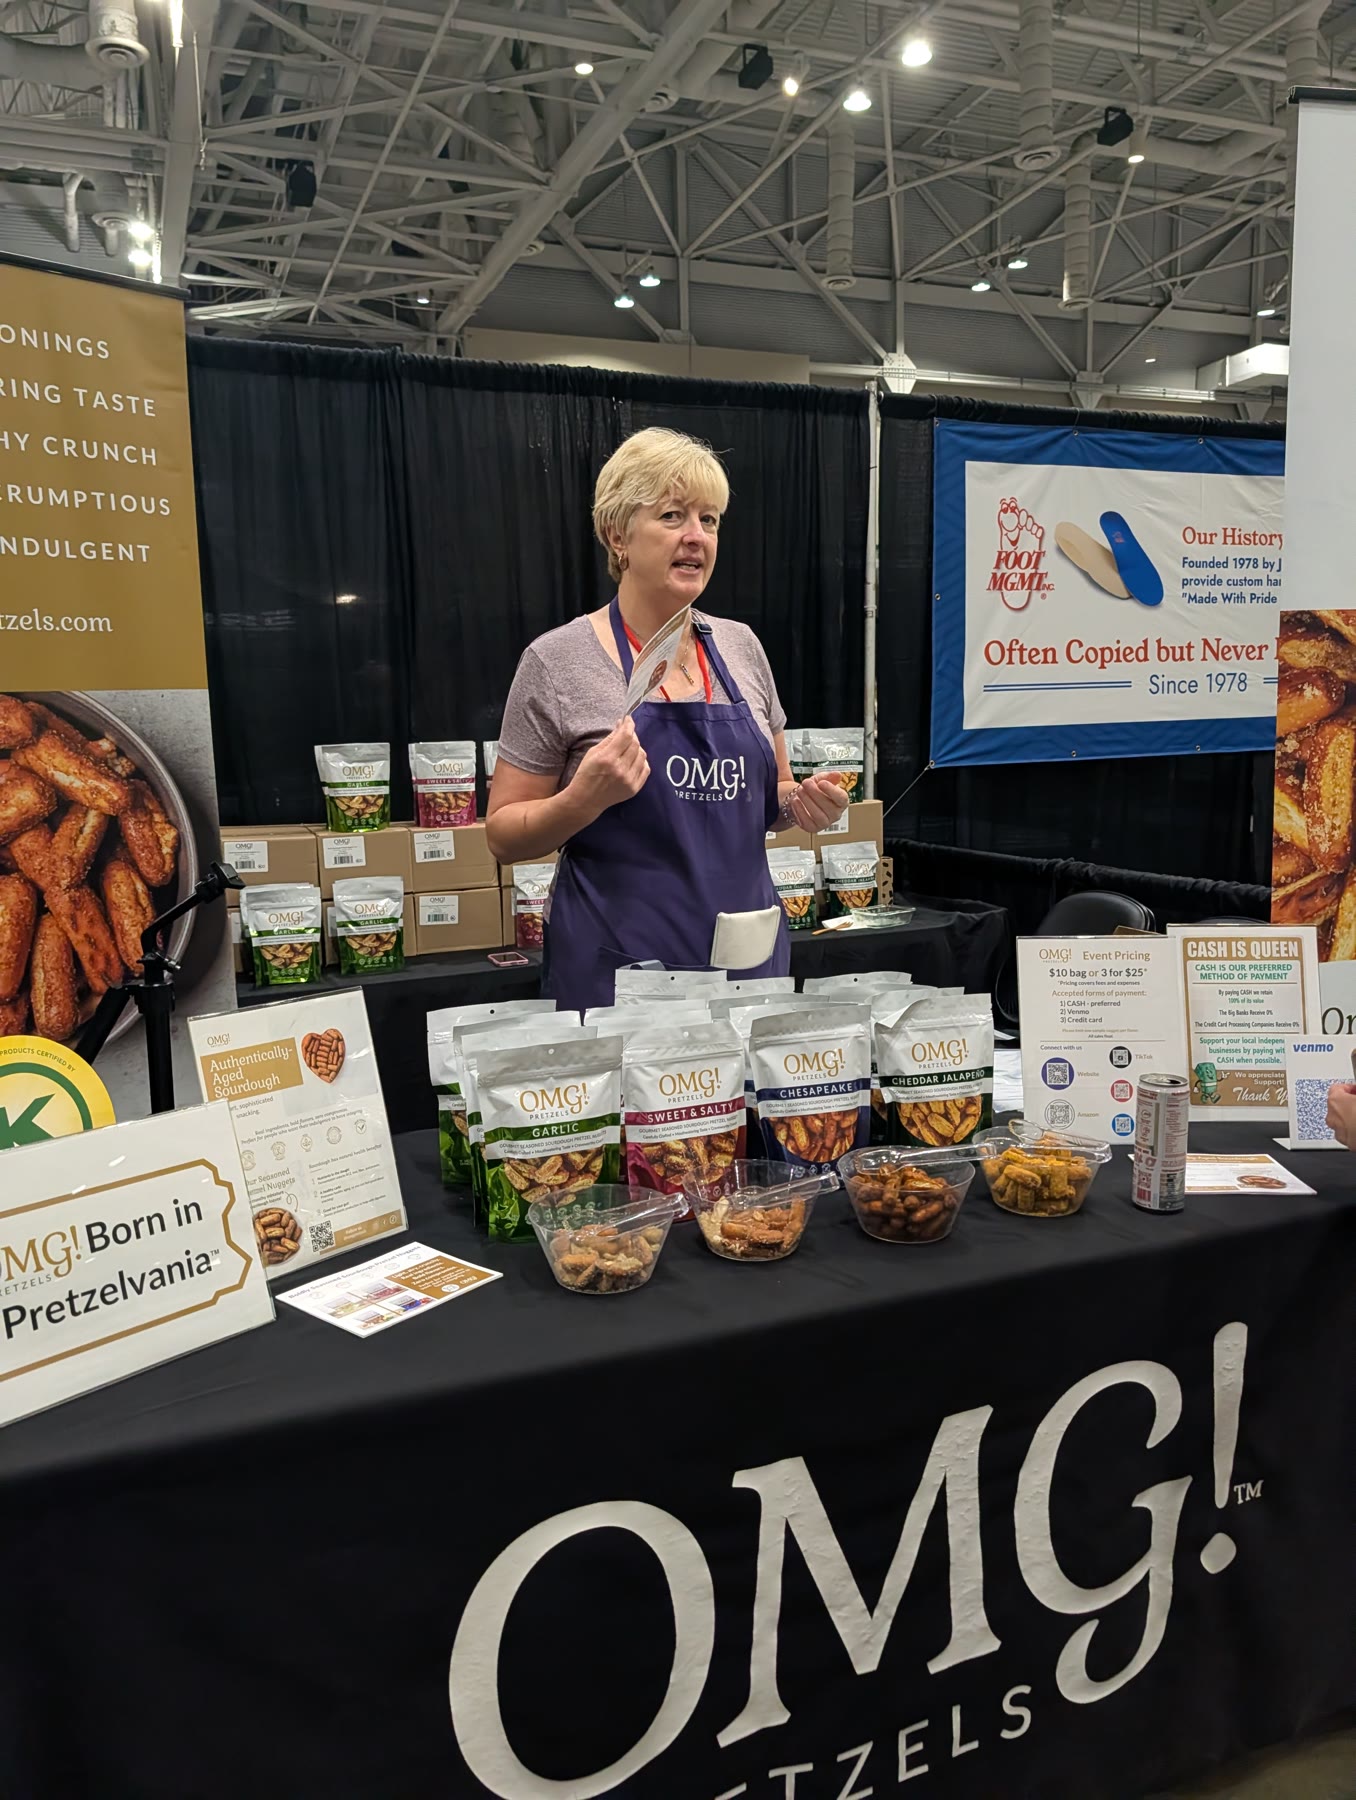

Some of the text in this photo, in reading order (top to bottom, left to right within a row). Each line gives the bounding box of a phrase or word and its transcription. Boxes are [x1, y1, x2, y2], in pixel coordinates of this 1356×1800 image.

[0, 324, 110, 360] ONINGS
[73, 387, 157, 417] TASTE
[42, 436, 157, 466] CRUNCH
[0, 484, 171, 516] RUMPTIOUS
[1182, 526, 1283, 551] Our History
[0, 536, 151, 562] NDULGENT
[993, 550, 1046, 570] FOOT
[1182, 555, 1229, 569] Founded
[1232, 557, 1259, 569] 1978
[1262, 556, 1275, 572] by
[986, 572, 1048, 591] MGMT
[1182, 573, 1223, 590] provide
[1226, 576, 1263, 587] custom
[1182, 591, 1278, 604] "Made With Pride
[984, 639, 1058, 666] Often
[1065, 638, 1150, 669] Copied
[1156, 637, 1195, 662] but
[1201, 637, 1269, 662] Never
[1149, 673, 1248, 695] Since 1978
[342, 765, 375, 779] OMG!
[433, 763, 465, 777] OMG!
[666, 755, 746, 800] OMG!
[268, 911, 305, 926] OMG!
[1039, 949, 1151, 963] OMG! Event Pricing
[1187, 941, 1299, 960] CASH IS QUEEN
[1049, 968, 1067, 977] $10
[1069, 968, 1087, 979] bag
[1101, 968, 1107, 977] 3
[1109, 968, 1123, 977] for
[1251, 972, 1288, 980] PAYMENT
[1052, 990, 1084, 998] Accepted
[1091, 1000, 1121, 1008] preferred
[207, 1033, 231, 1046] OMG!
[1200, 1037, 1225, 1045] Support
[1293, 1043, 1334, 1053] venmo
[210, 1046, 293, 1072] Authentically-
[911, 1038, 969, 1066] OMG!
[1243, 1047, 1250, 1055] by
[1252, 1047, 1274, 1055] paying
[0, 1048, 76, 1072] PRODUCTS CERTIFIED BY
[783, 1048, 845, 1077] OMG!
[918, 1061, 952, 1069] PRETZELS
[1254, 1056, 1282, 1064] possible.
[213, 1067, 244, 1087] Aged
[659, 1067, 722, 1098] OMG!
[792, 1072, 827, 1081] PRETZELS
[892, 1069, 985, 1086] CHEDDAR JALAPEÑO
[1248, 1071, 1285, 1079] appreciate
[214, 1074, 281, 1098] Sourdough
[780, 1082, 852, 1098] CHESAPEAKE
[1233, 1087, 1271, 1101] Thank
[239, 1096, 274, 1110] sophisticated
[519, 1082, 590, 1114] OMG!
[667, 1093, 704, 1103] PRETZELS
[529, 1110, 569, 1120] PRETZELS
[647, 1102, 733, 1123] SWEET & SALTY
[532, 1123, 579, 1137] GARLIC
[684, 1121, 709, 1129] SOURDOUGH
[258, 1167, 290, 1183] Seasoned
[267, 1177, 296, 1191] Nuggets
[0, 1198, 203, 1282] MG! Born in
[0, 1274, 52, 1297] ETZELS
[2, 1249, 213, 1340] Pretzelvania
[448, 1321, 1248, 1800] OMG!
[713, 1684, 1032, 1800] TZELS
